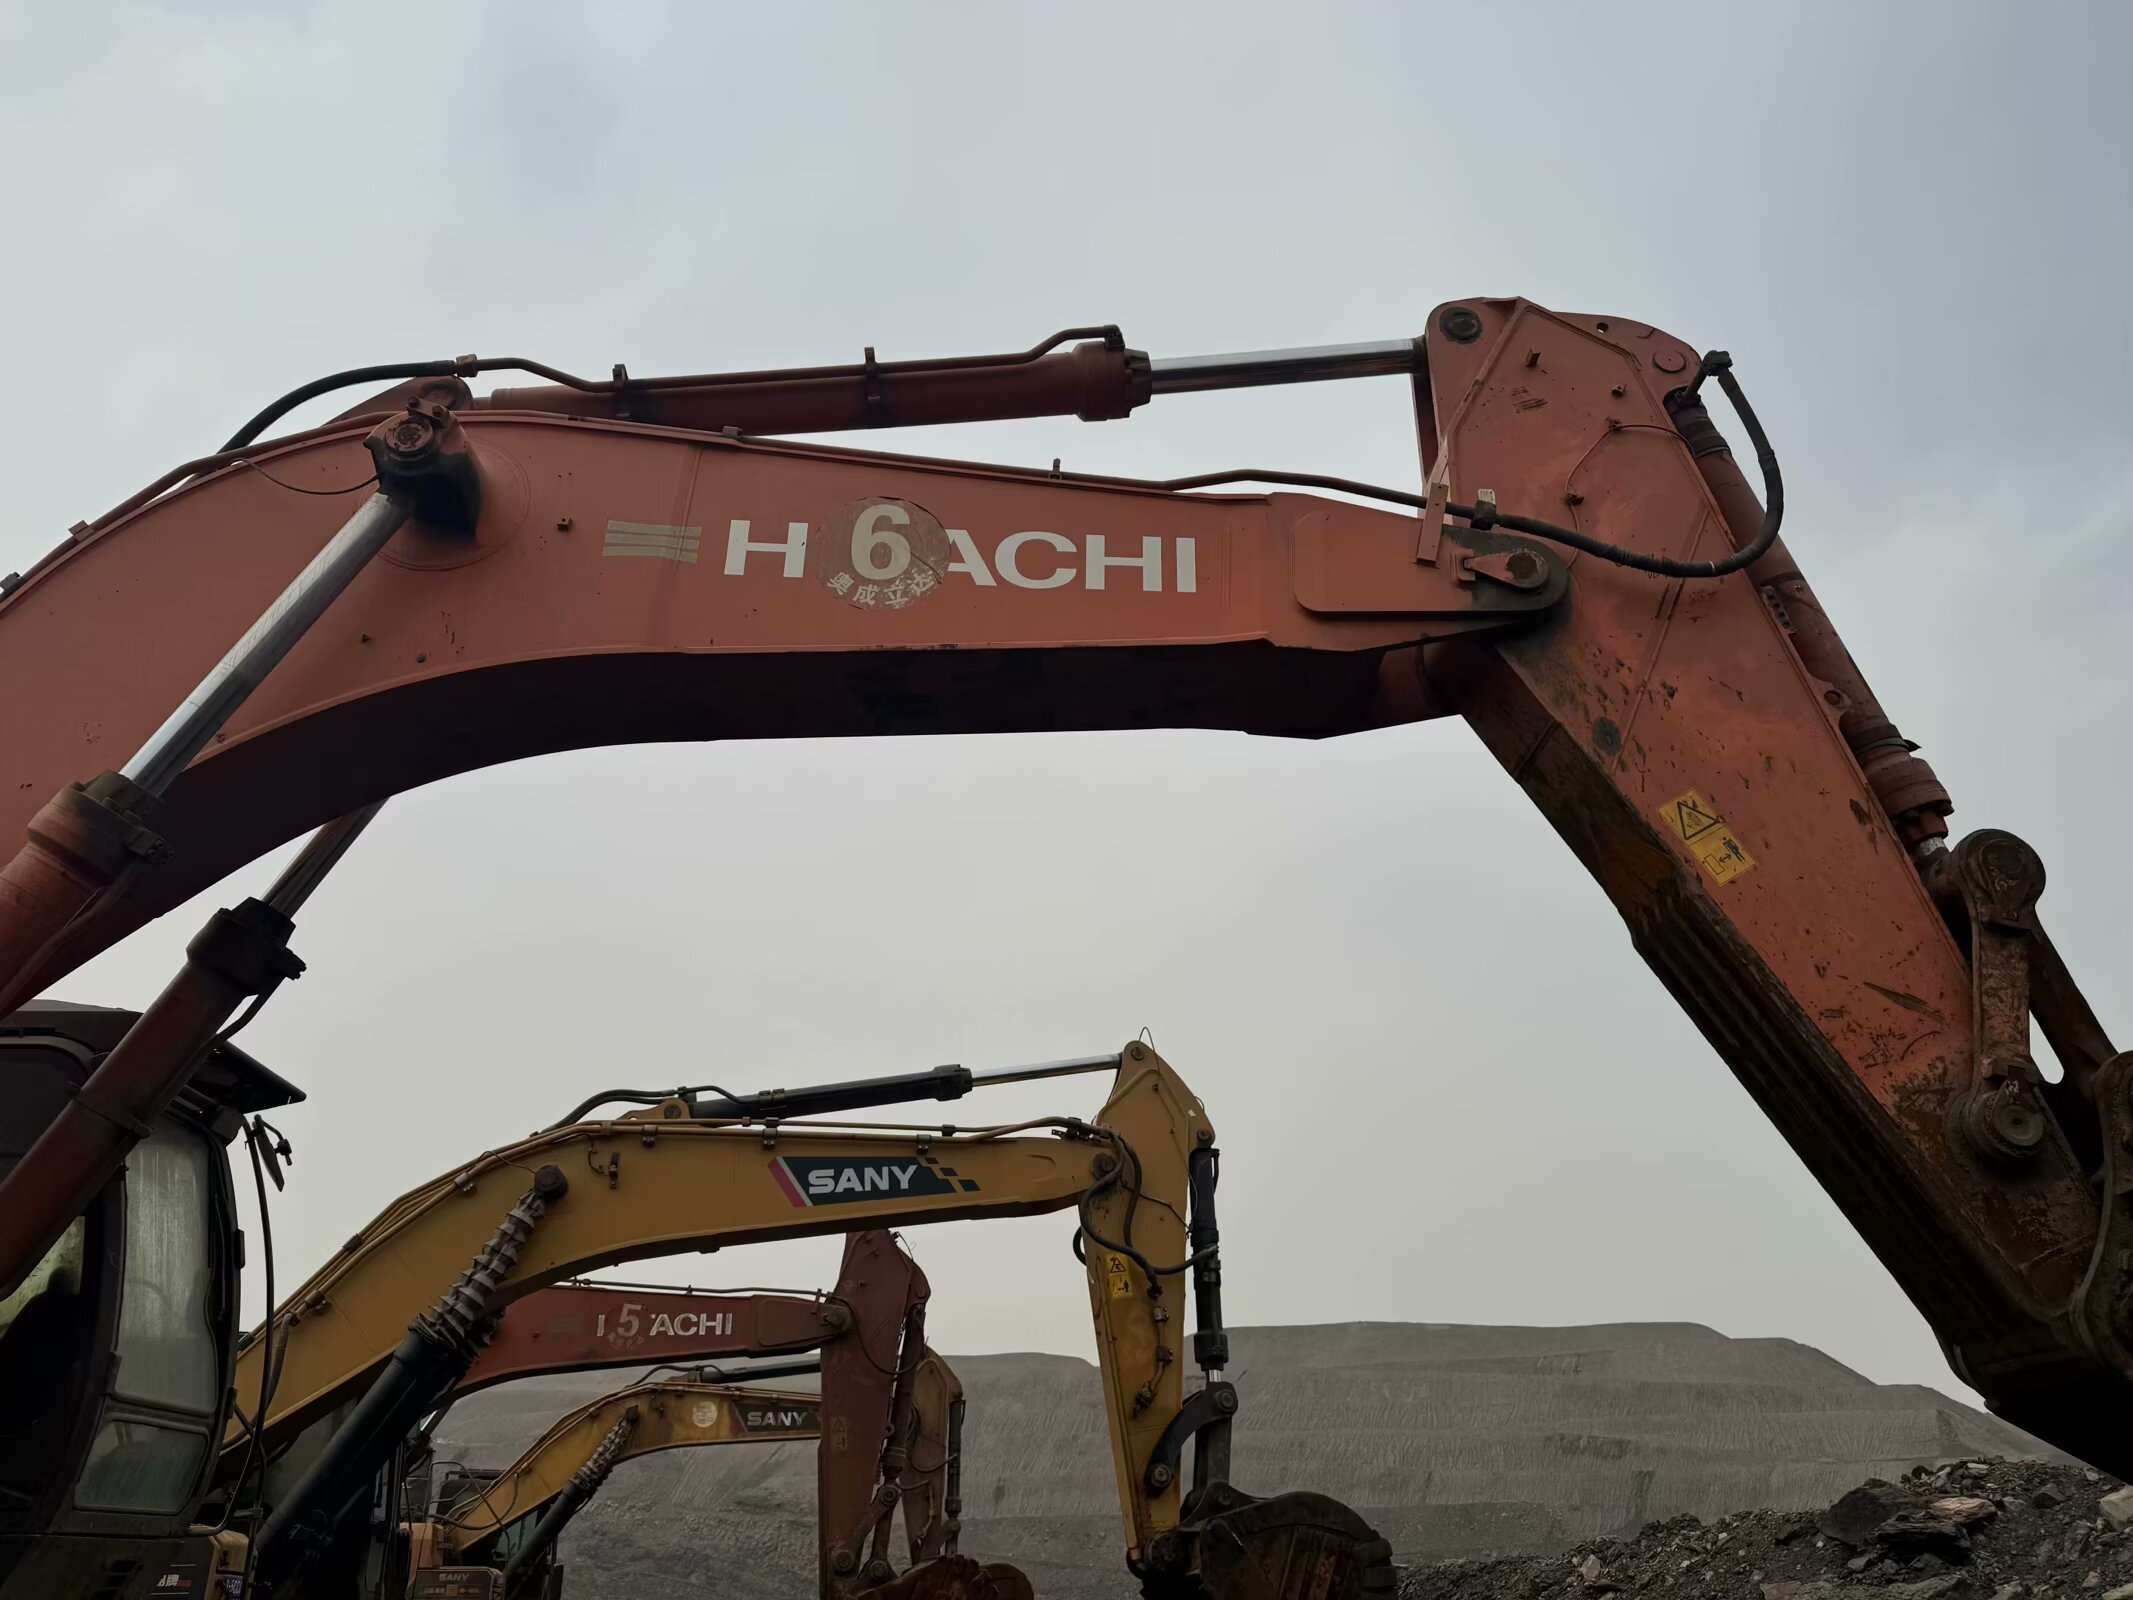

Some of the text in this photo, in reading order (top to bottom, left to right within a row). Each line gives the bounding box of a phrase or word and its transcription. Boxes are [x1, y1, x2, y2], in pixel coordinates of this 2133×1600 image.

[724, 519, 1196, 592] HACHI
[850, 503, 911, 580] 6
[807, 1165, 918, 1195] SANY
[617, 1303, 642, 1337] 5
[747, 1411, 808, 1427] SANY
